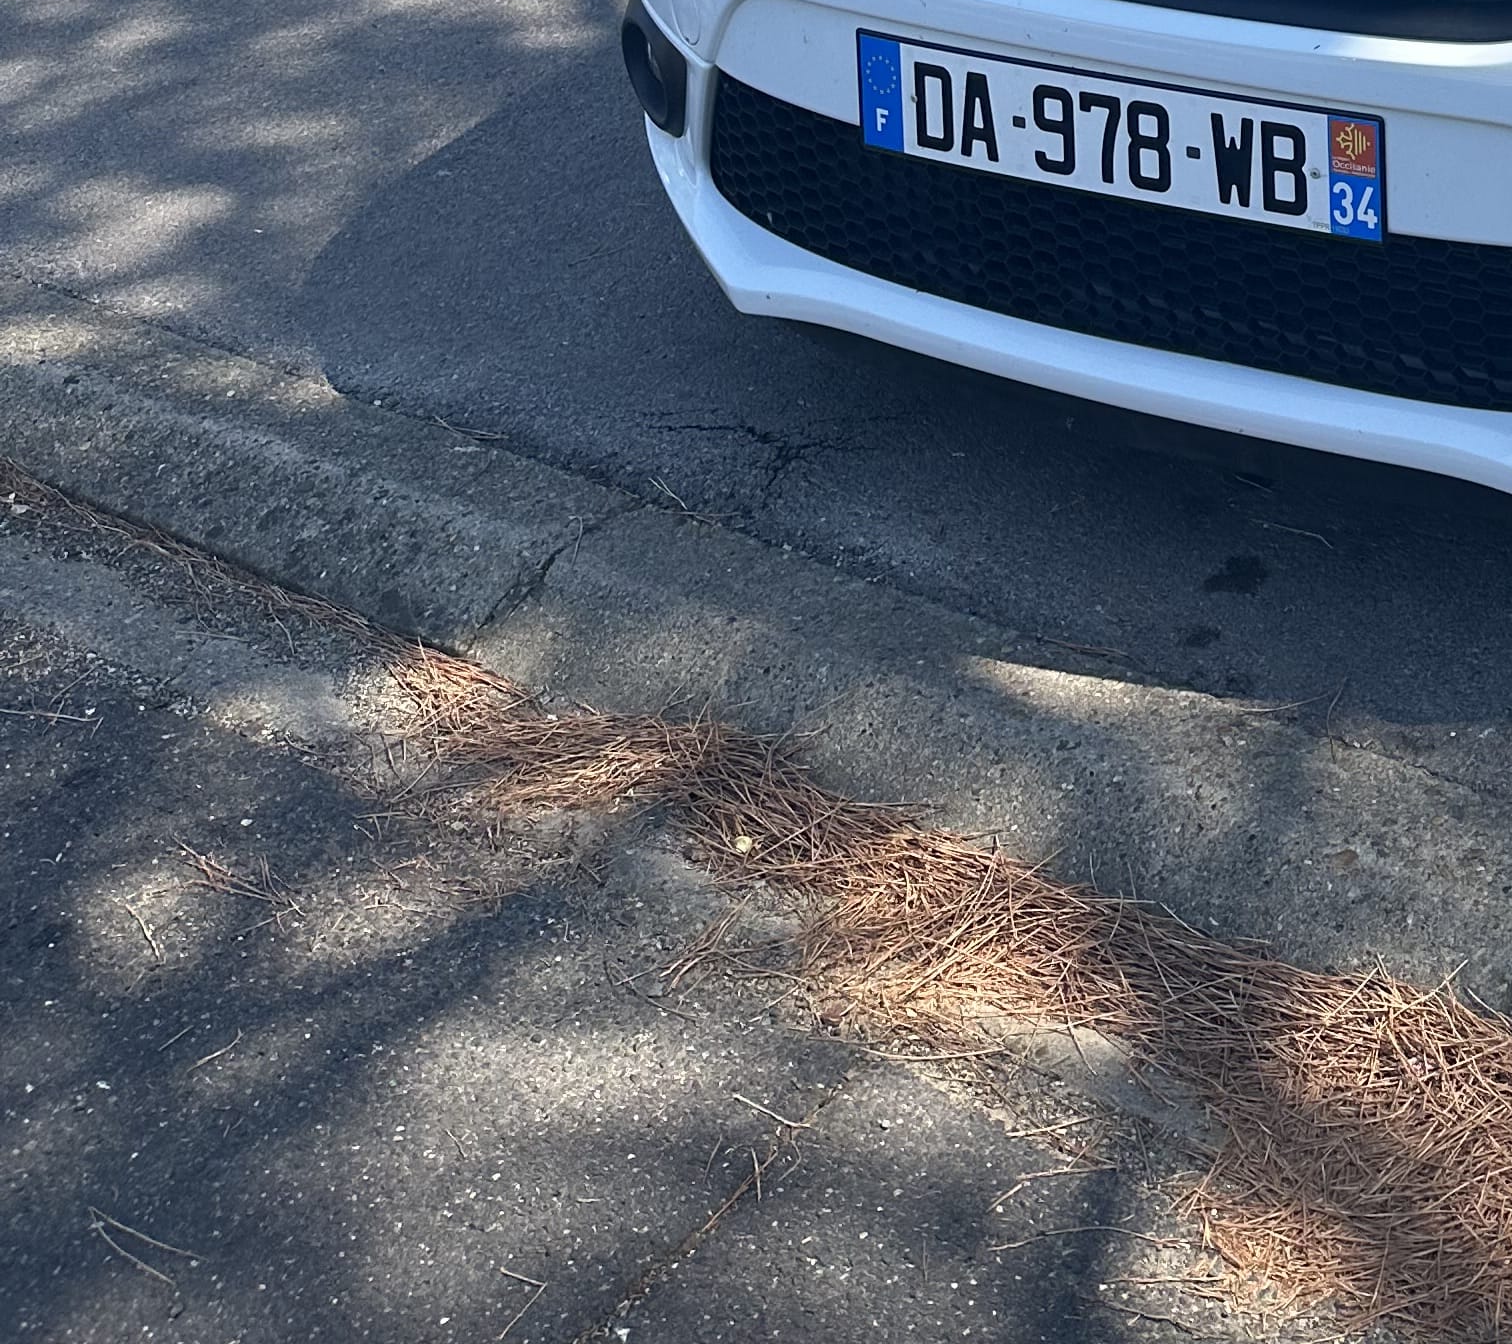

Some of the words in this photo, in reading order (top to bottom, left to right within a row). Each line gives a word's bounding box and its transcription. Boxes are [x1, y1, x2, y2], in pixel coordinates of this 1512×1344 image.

[875, 107, 889, 132] F
[913, 61, 1309, 216] DA-978-WB
[1332, 181, 1378, 230] 34
